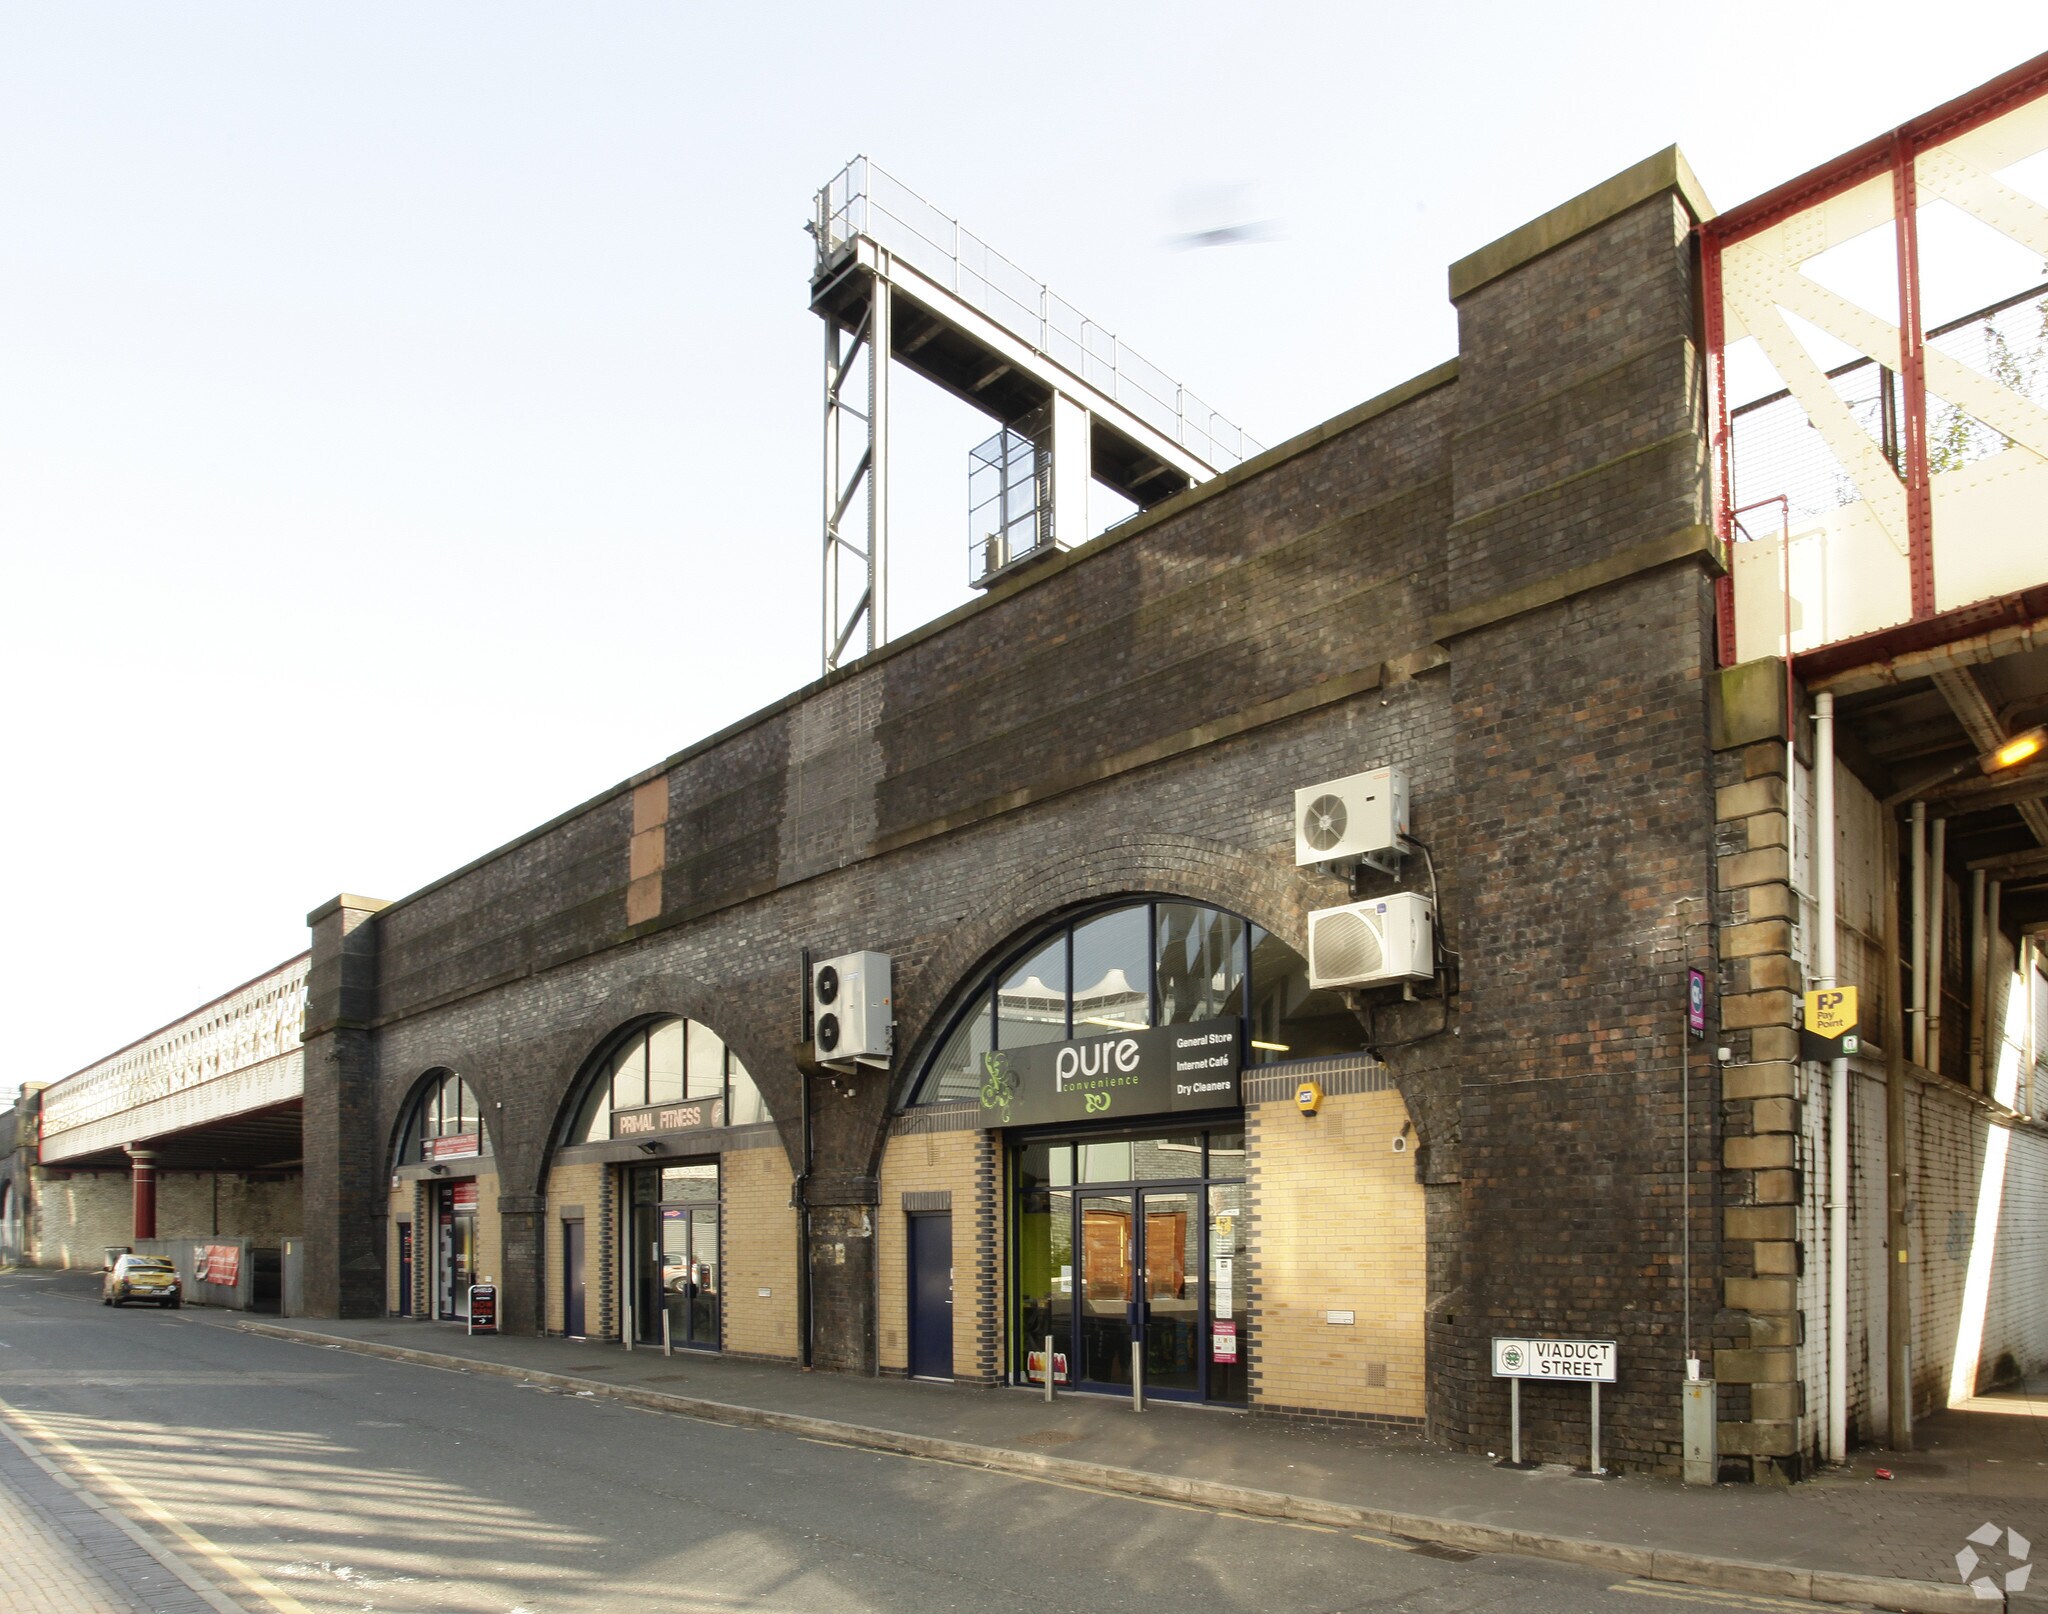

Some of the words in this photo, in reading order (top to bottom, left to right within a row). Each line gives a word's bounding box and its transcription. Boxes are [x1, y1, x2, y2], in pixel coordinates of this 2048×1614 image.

[1817, 1011, 1834, 1020] Pay
[1817, 1019, 1844, 1028] Point
[1176, 1036, 1208, 1048] General
[1209, 1032, 1232, 1044] Store
[1056, 1038, 1139, 1092] pure
[1176, 1059, 1208, 1071] Internet
[1209, 1053, 1228, 1067] Café
[1063, 1075, 1139, 1092] convenience
[1176, 1083, 1191, 1096] Dry
[1193, 1079, 1231, 1093] Cleaners
[620, 1113, 655, 1134] PRIMAL
[660, 1107, 700, 1129] FITNESS
[1536, 1343, 1609, 1359] VIADUCT
[1541, 1360, 1602, 1376] STREET
